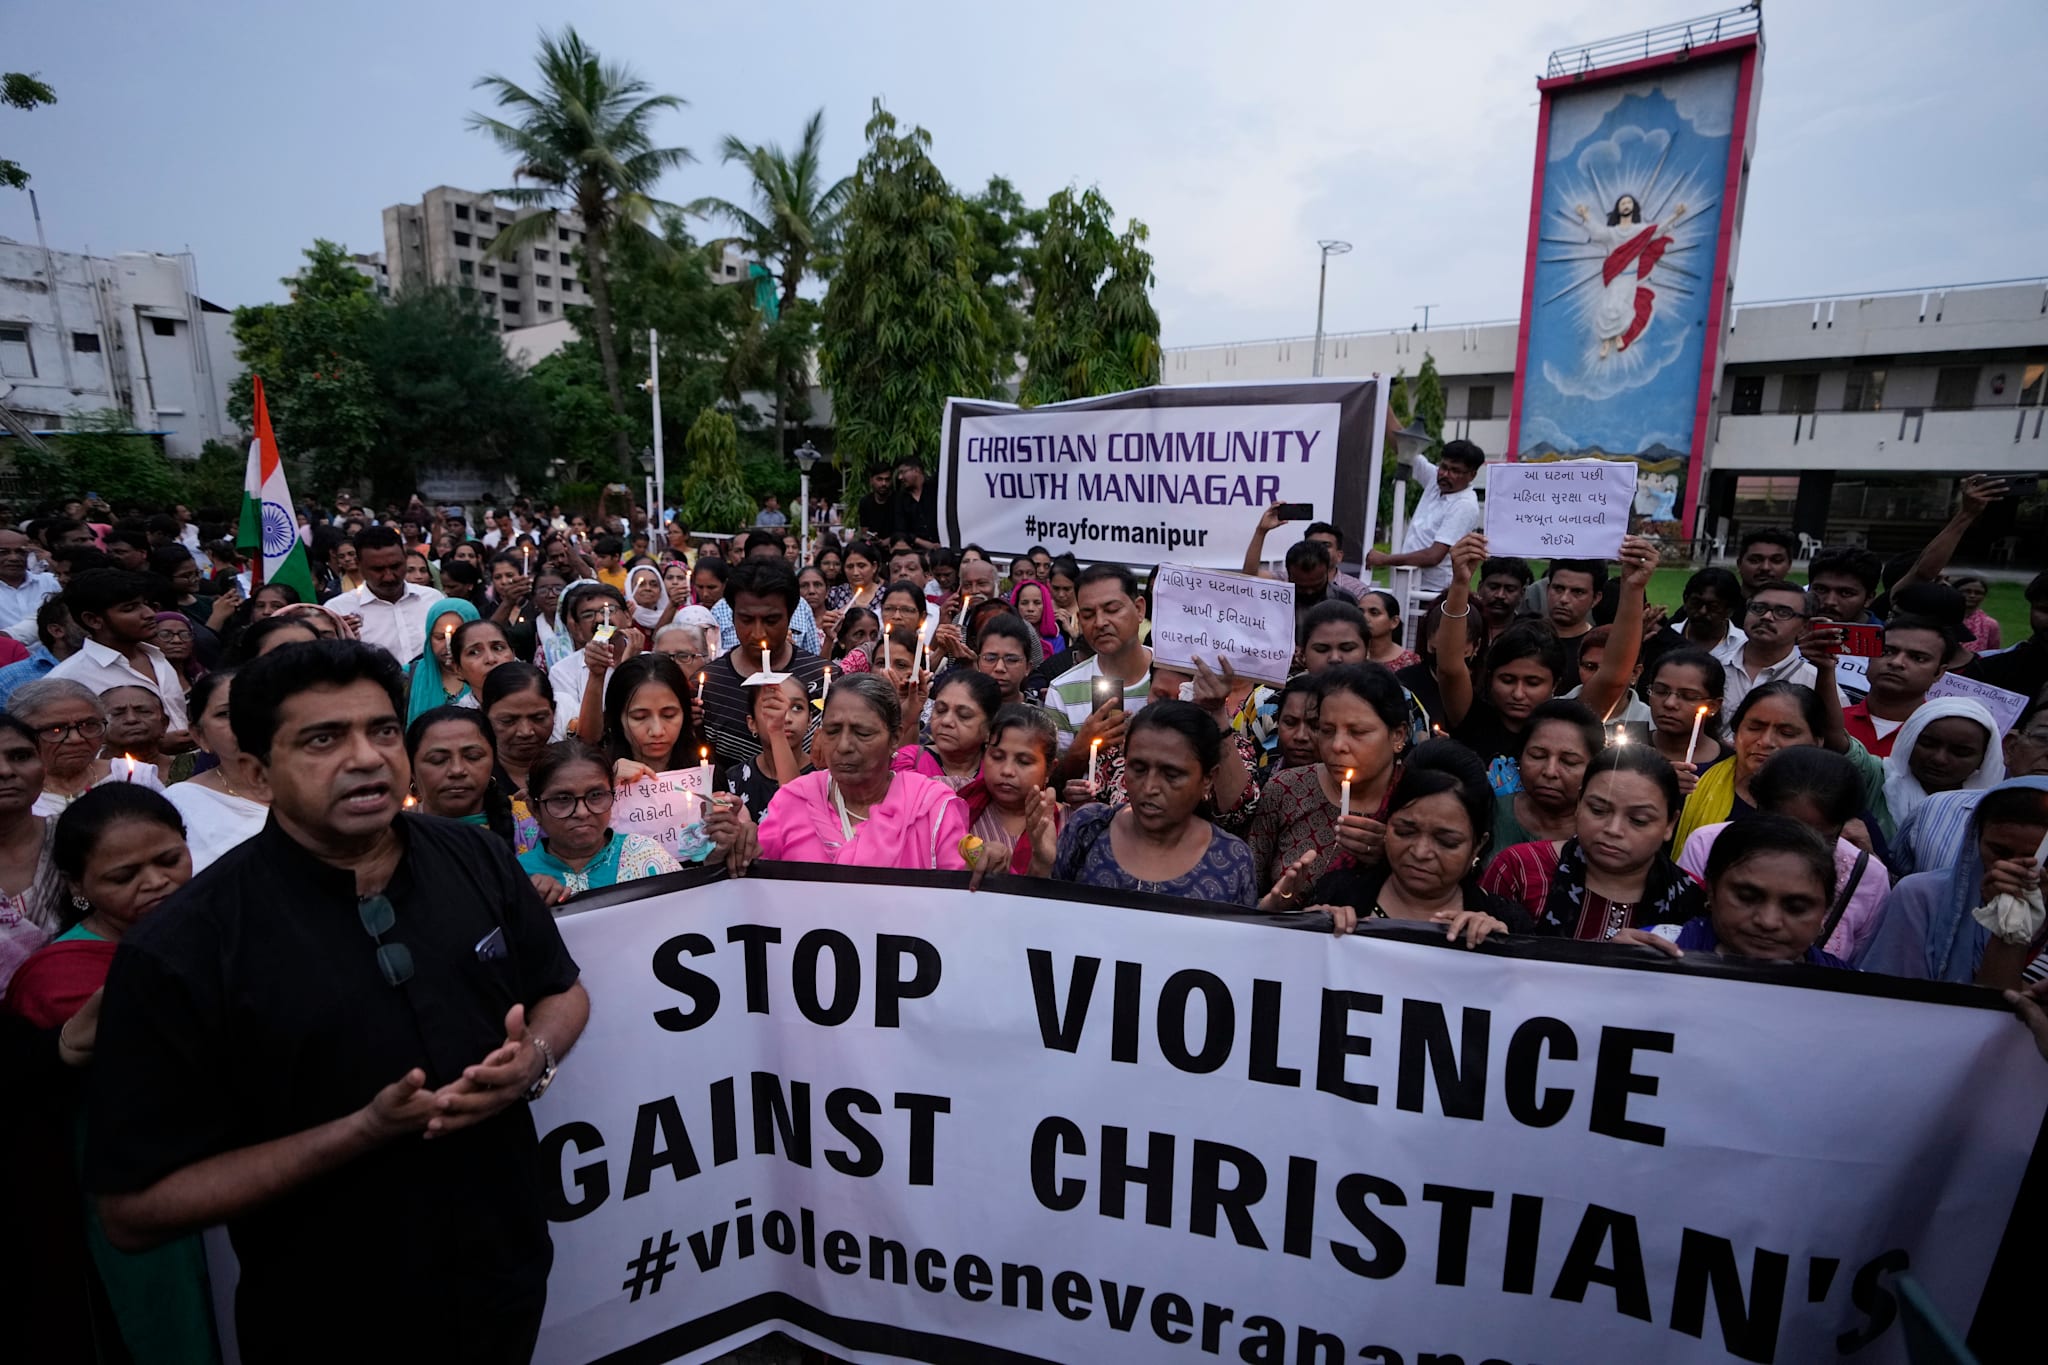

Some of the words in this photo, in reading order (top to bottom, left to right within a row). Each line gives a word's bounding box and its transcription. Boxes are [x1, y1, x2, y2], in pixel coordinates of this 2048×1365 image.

[967, 433, 1097, 463] CHRISTIAN
[1107, 430, 1322, 463] COMMUNITY
[1523, 471, 1540, 481] આ
[1544, 471, 1575, 481] ઘટના
[1580, 467, 1604, 481] પછી
[984, 472, 1068, 501] YOUTH
[1078, 473, 1280, 507] MANINAGAR
[1513, 489, 1546, 503] મહિલા
[1551, 492, 1582, 505] સુરક્ષા
[1558, 511, 1606, 525] બનાવવી
[1025, 514, 1210, 552] #prayformanipur
[1162, 571, 1203, 592] મણિપુર
[1181, 603, 1212, 618] આખી
[1160, 630, 1209, 647] ભારતની
[652, 923, 942, 1034] STOP
[1026, 948, 1675, 1149] VIOLENCE
[540, 1071, 952, 1222] GAINST
[1030, 1115, 1910, 1365] CHRISTIAN'S
